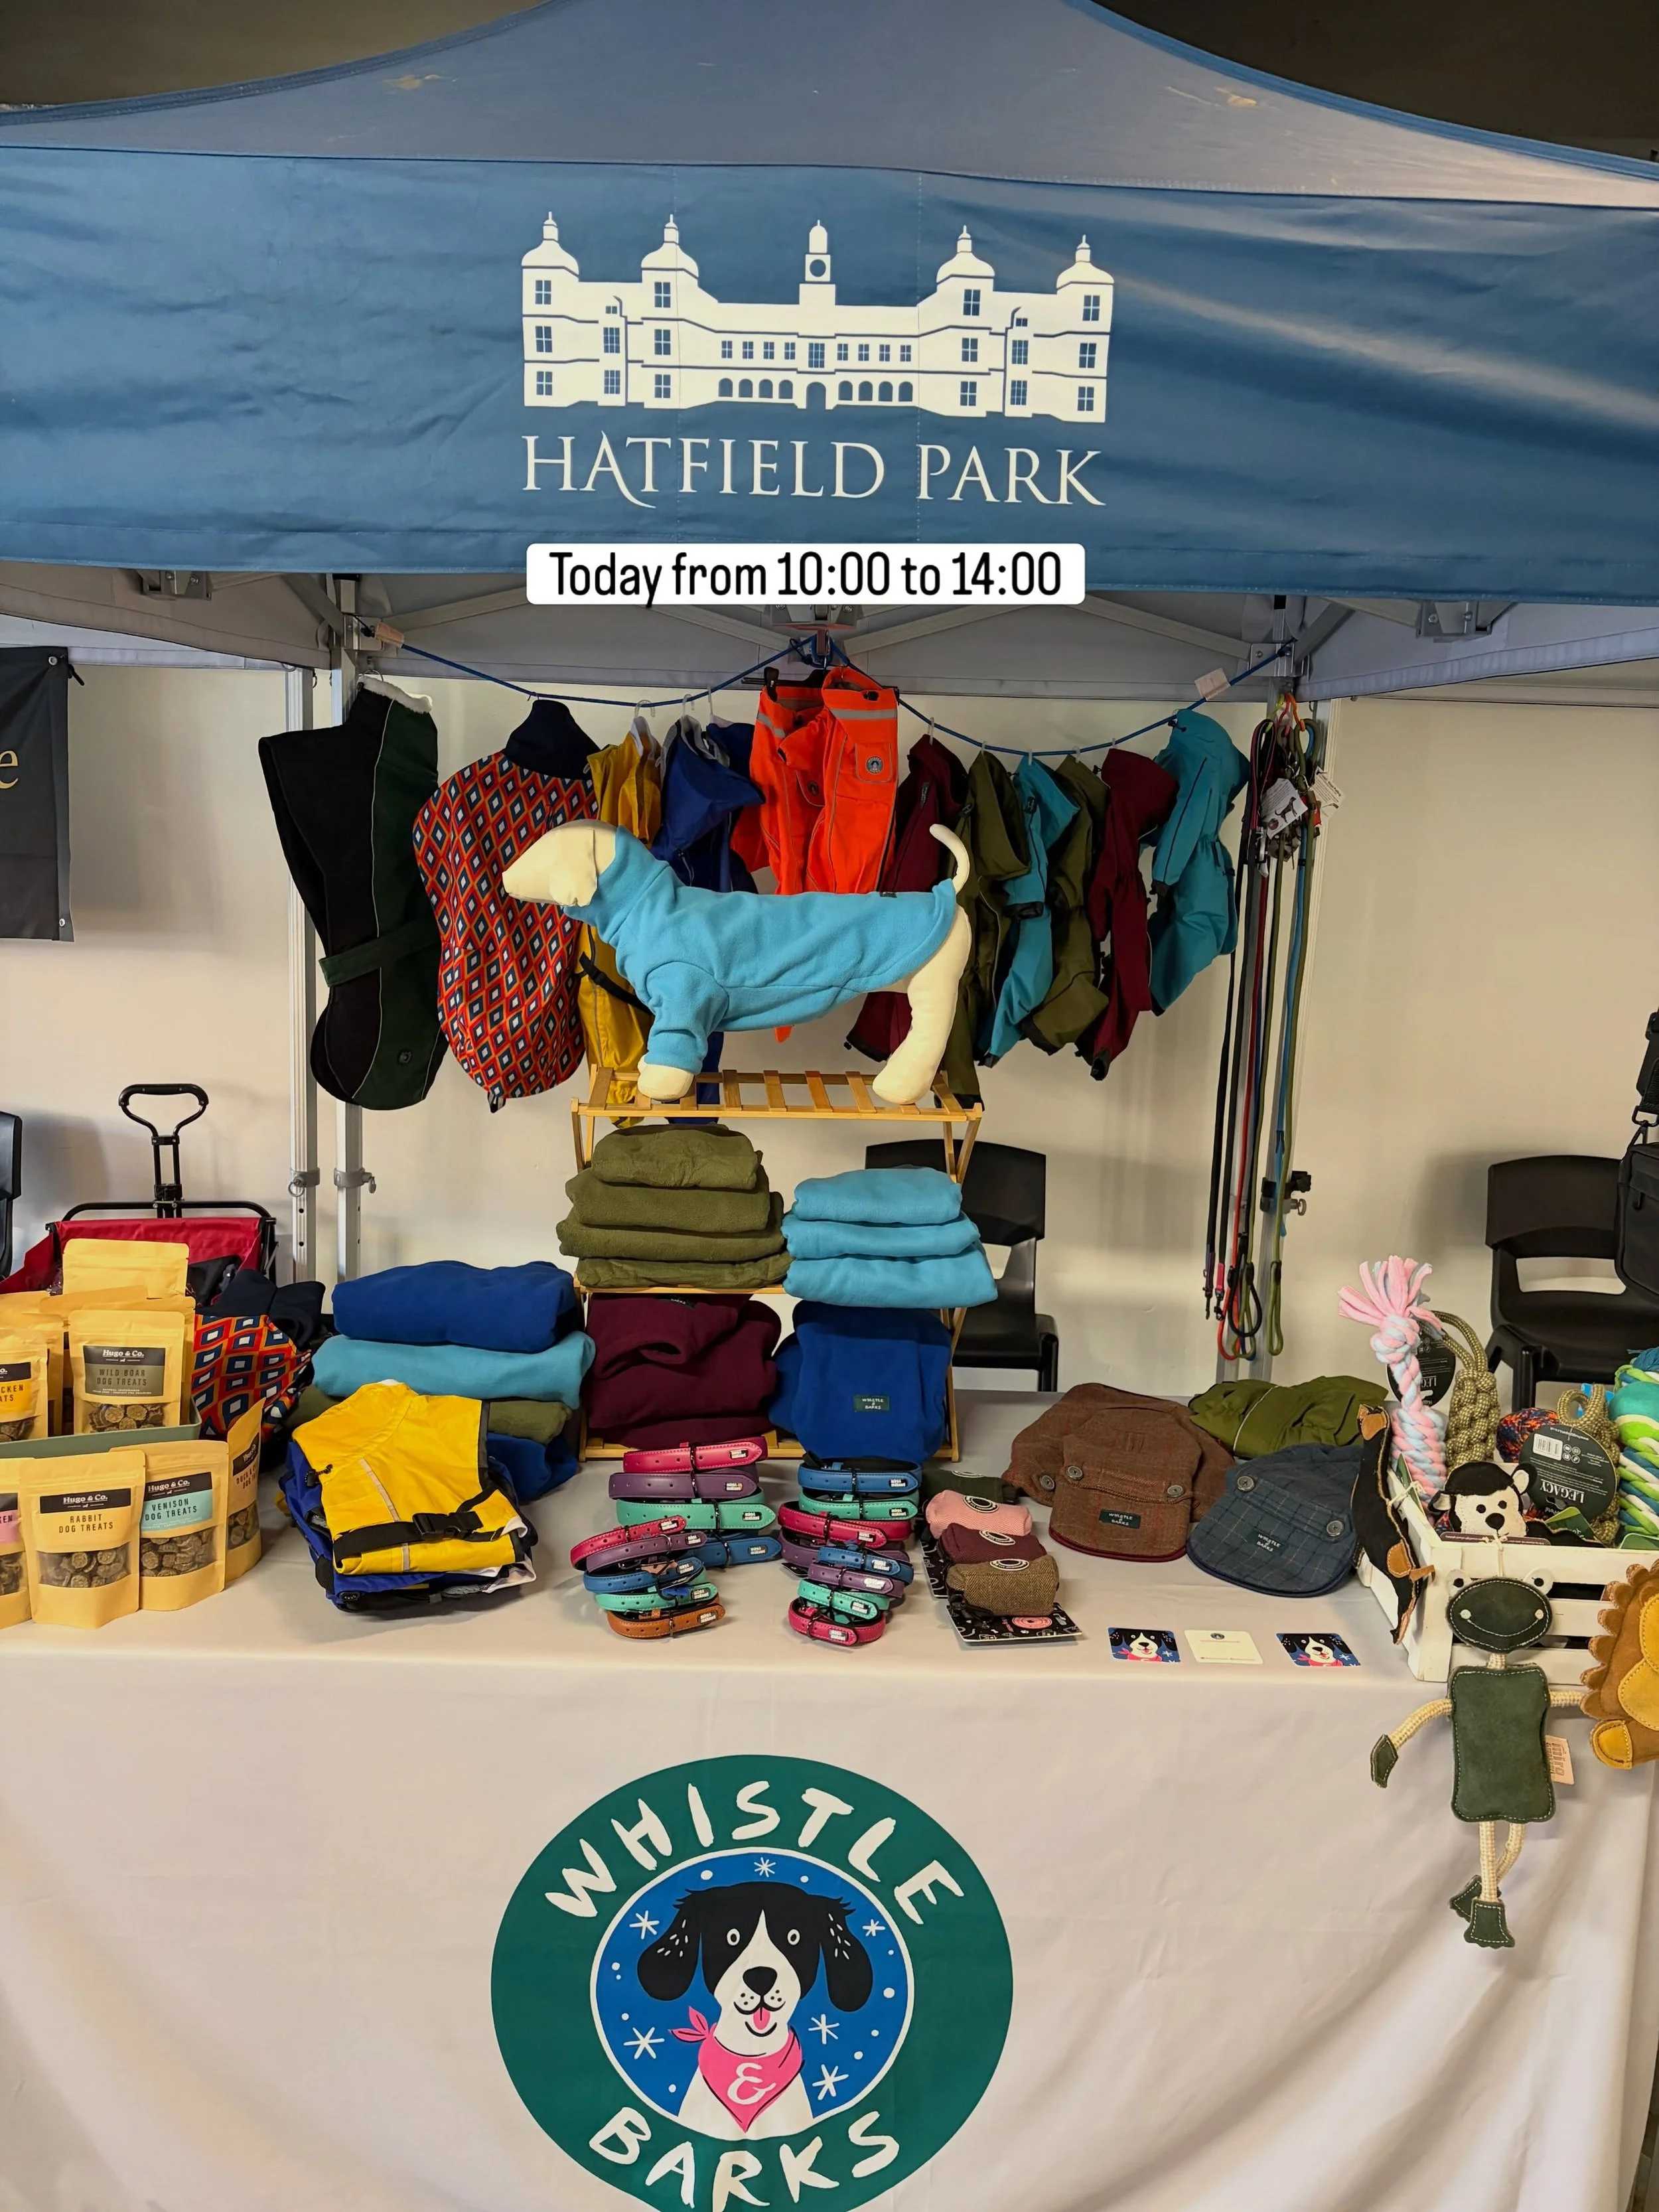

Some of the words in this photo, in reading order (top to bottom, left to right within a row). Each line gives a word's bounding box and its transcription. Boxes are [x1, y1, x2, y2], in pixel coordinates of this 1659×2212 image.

[521, 430, 885, 508] HATFIELD
[916, 443, 1107, 506] PARK
[148, 1483, 169, 1492] Hugo
[1540, 1481, 1585, 1504] LEGACY
[152, 1498, 189, 1511] VENISON
[70, 1514, 102, 1523] RABBIT
[145, 1512, 161, 1521] DOG
[167, 1505, 197, 1518] TREATS
[59, 1525, 76, 1534] DOG
[81, 1522, 113, 1532] TREATS
[544, 1780, 965, 1925] WHISTLE
[589, 2110, 900, 2212] BARKS
